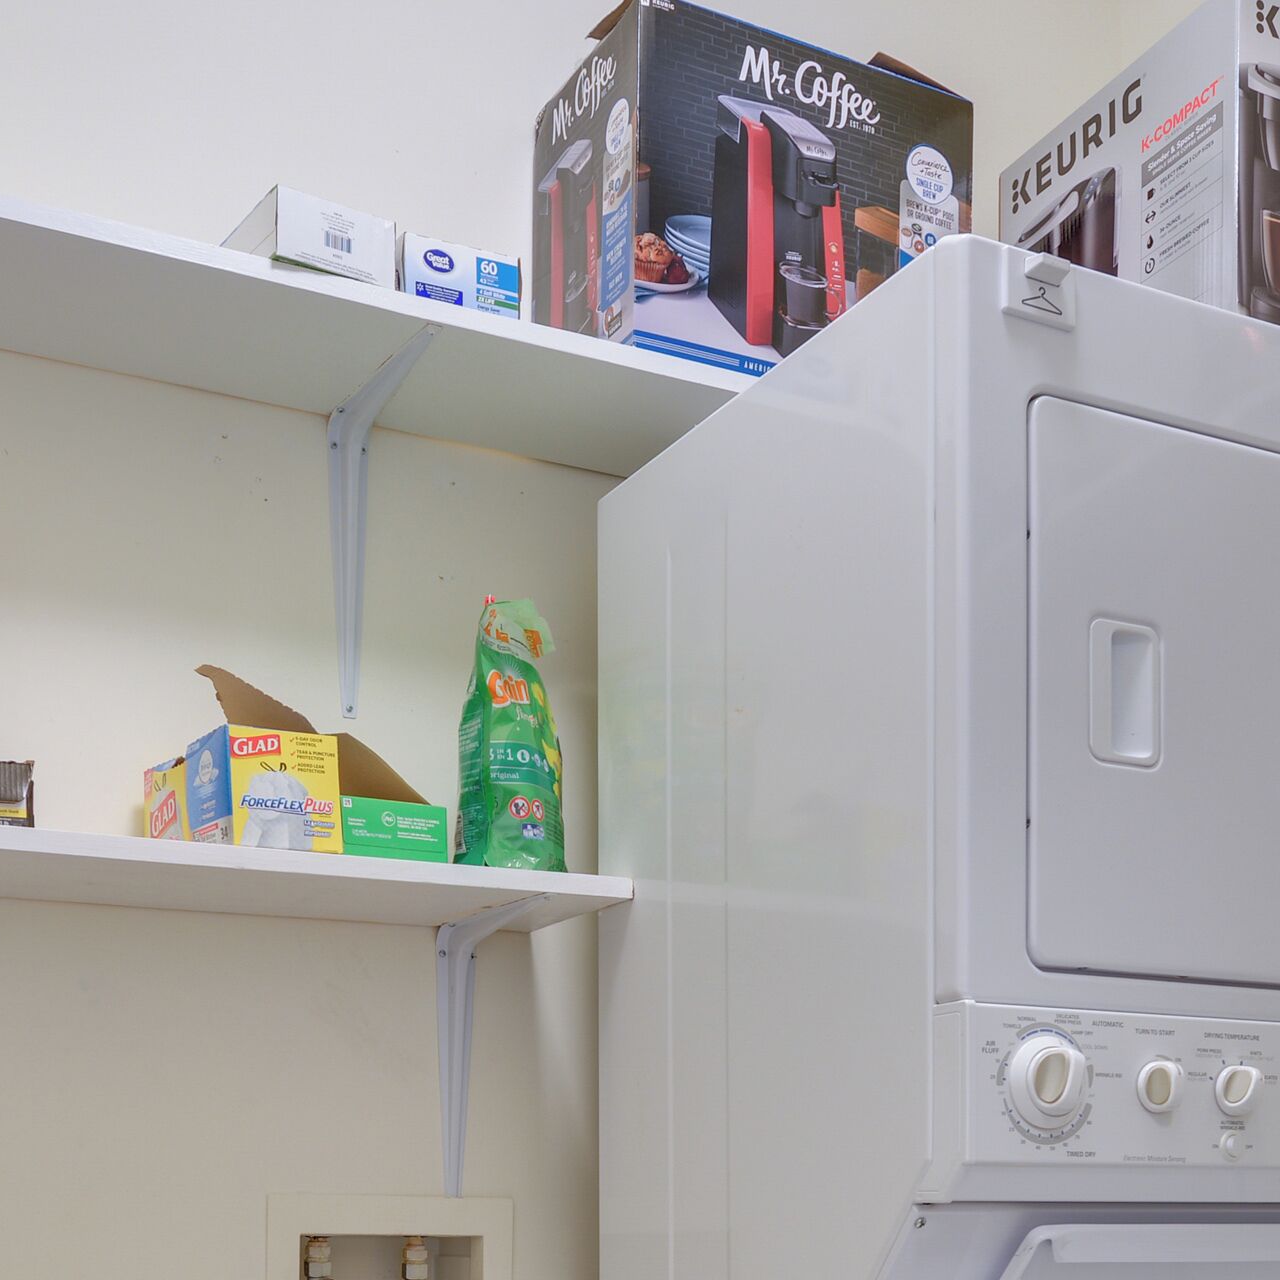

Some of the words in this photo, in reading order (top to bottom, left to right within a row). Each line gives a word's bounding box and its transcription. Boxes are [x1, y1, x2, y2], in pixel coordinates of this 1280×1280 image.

[552, 98, 574, 145] Mr.
[575, 56, 617, 119] Coffee
[739, 45, 791, 100] Mr.
[795, 61, 880, 129] Coffee
[1140, 80, 1219, 153] K-COMPACT
[1011, 78, 1144, 215] KEURIG
[1147, 151, 1170, 172] Slender
[1176, 129, 1195, 151] Space
[1195, 114, 1217, 136] Saving
[923, 189, 937, 200] BREW
[426, 252, 450, 266] Great
[480, 261, 498, 275] 60
[487, 669, 530, 708] Gain
[232, 737, 279, 756] GLAD
[151, 798, 176, 838] GLAD
